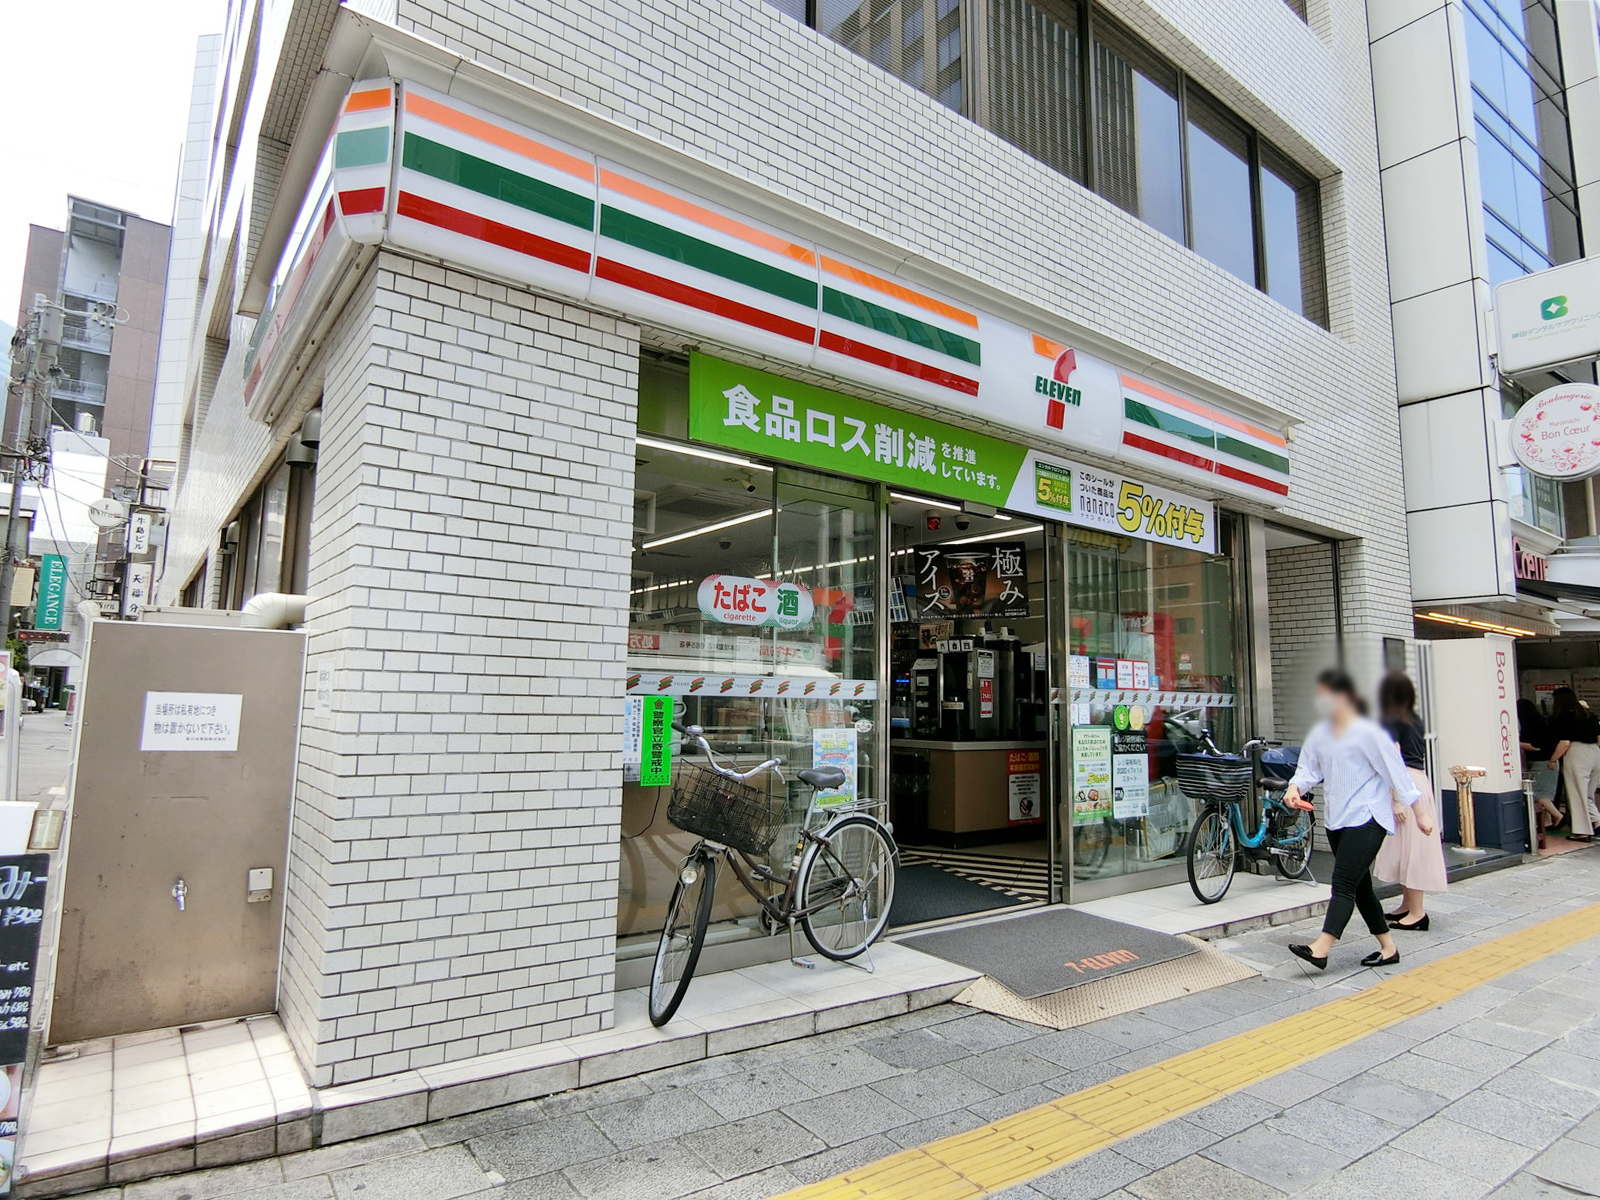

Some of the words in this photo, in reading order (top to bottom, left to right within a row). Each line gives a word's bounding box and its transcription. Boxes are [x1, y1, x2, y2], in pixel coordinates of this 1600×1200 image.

[1536, 393, 1593, 410] Boulangerie
[721, 383, 938, 476] 食品ロス削減
[1541, 430, 1561, 441] Bon
[940, 441, 976, 466] を推進
[941, 461, 1002, 492] しています。
[1079, 471, 1115, 488] このシールが
[1079, 483, 1115, 499] ついた商品は
[1080, 495, 1115, 519] nanaco
[1116, 479, 1205, 544] 5%付与
[918, 549, 945, 613] アイス
[991, 547, 1025, 606] 極み
[45, 560, 63, 625] ELEGANCE
[713, 582, 767, 613] たばこ
[777, 588, 799, 617] 酒
[723, 613, 757, 622] cigarette
[779, 617, 800, 626] liquor
[1495, 651, 1506, 699] Bon
[155, 703, 217, 717] 当場所は私有地につき
[154, 722, 231, 735] 物は置かないで下さい。
[7, 961, 31, 972] etc
